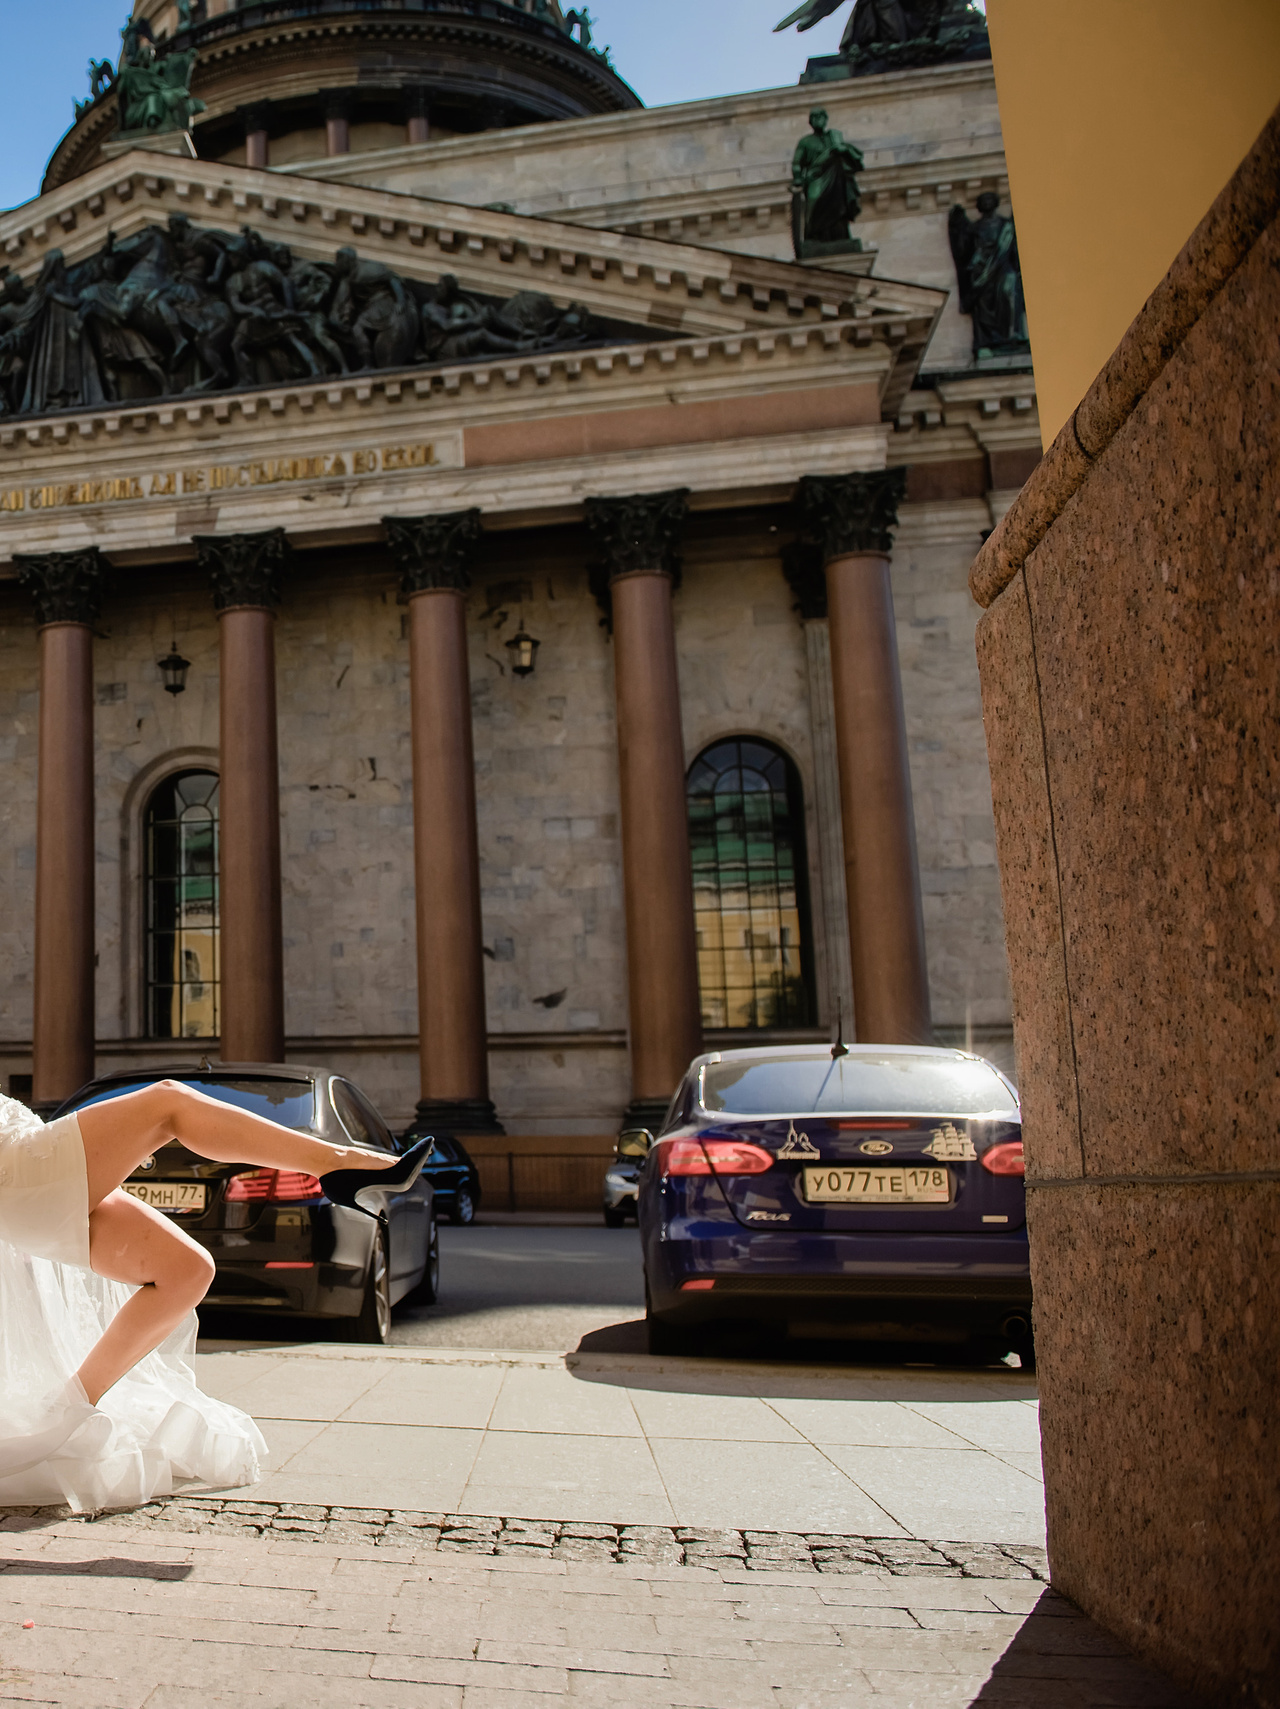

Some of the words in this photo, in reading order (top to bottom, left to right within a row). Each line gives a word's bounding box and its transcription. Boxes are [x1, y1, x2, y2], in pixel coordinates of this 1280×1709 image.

[812, 1171, 903, 1193] У077ТЕ
[908, 1170, 943, 1187] 178
[121, 1186, 173, 1204] 59МН
